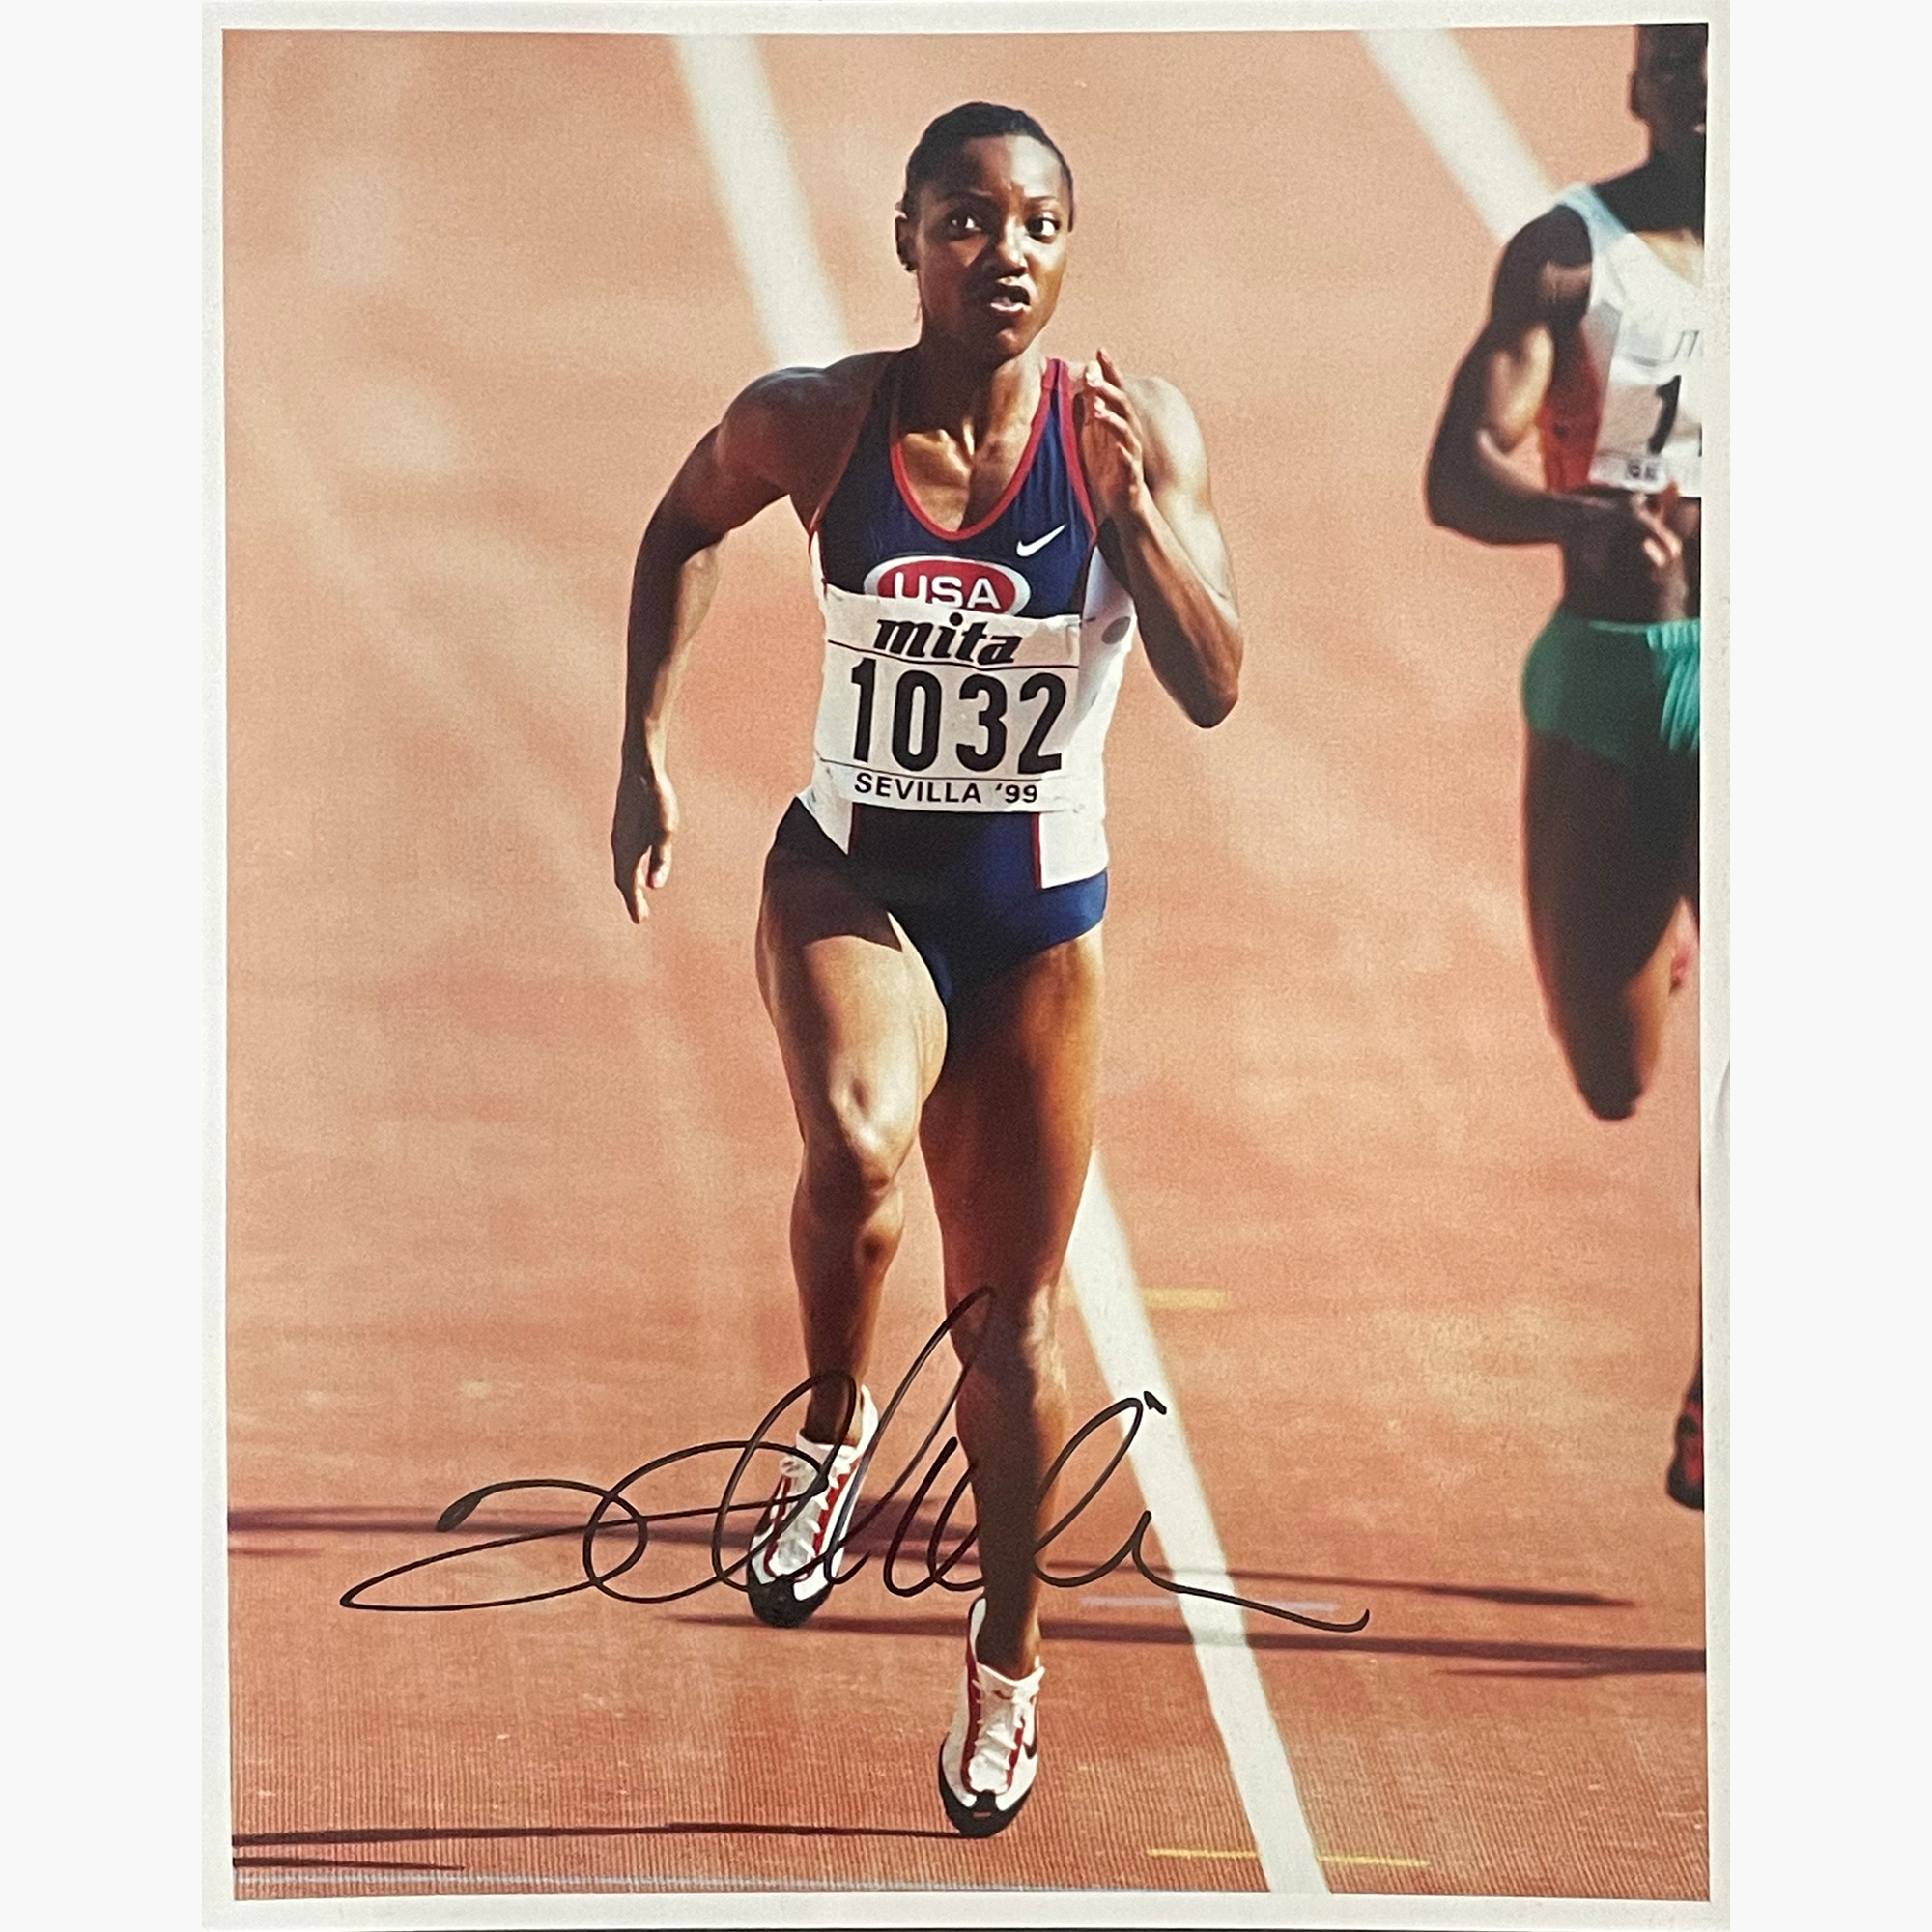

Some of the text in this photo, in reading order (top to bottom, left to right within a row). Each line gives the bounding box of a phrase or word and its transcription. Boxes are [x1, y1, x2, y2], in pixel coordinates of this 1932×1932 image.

[1647, 374, 1703, 457] 1
[894, 571, 1002, 610] USA
[873, 611, 1023, 665] mita
[851, 657, 1067, 774] 1032
[854, 772, 981, 804] SEVILLA
